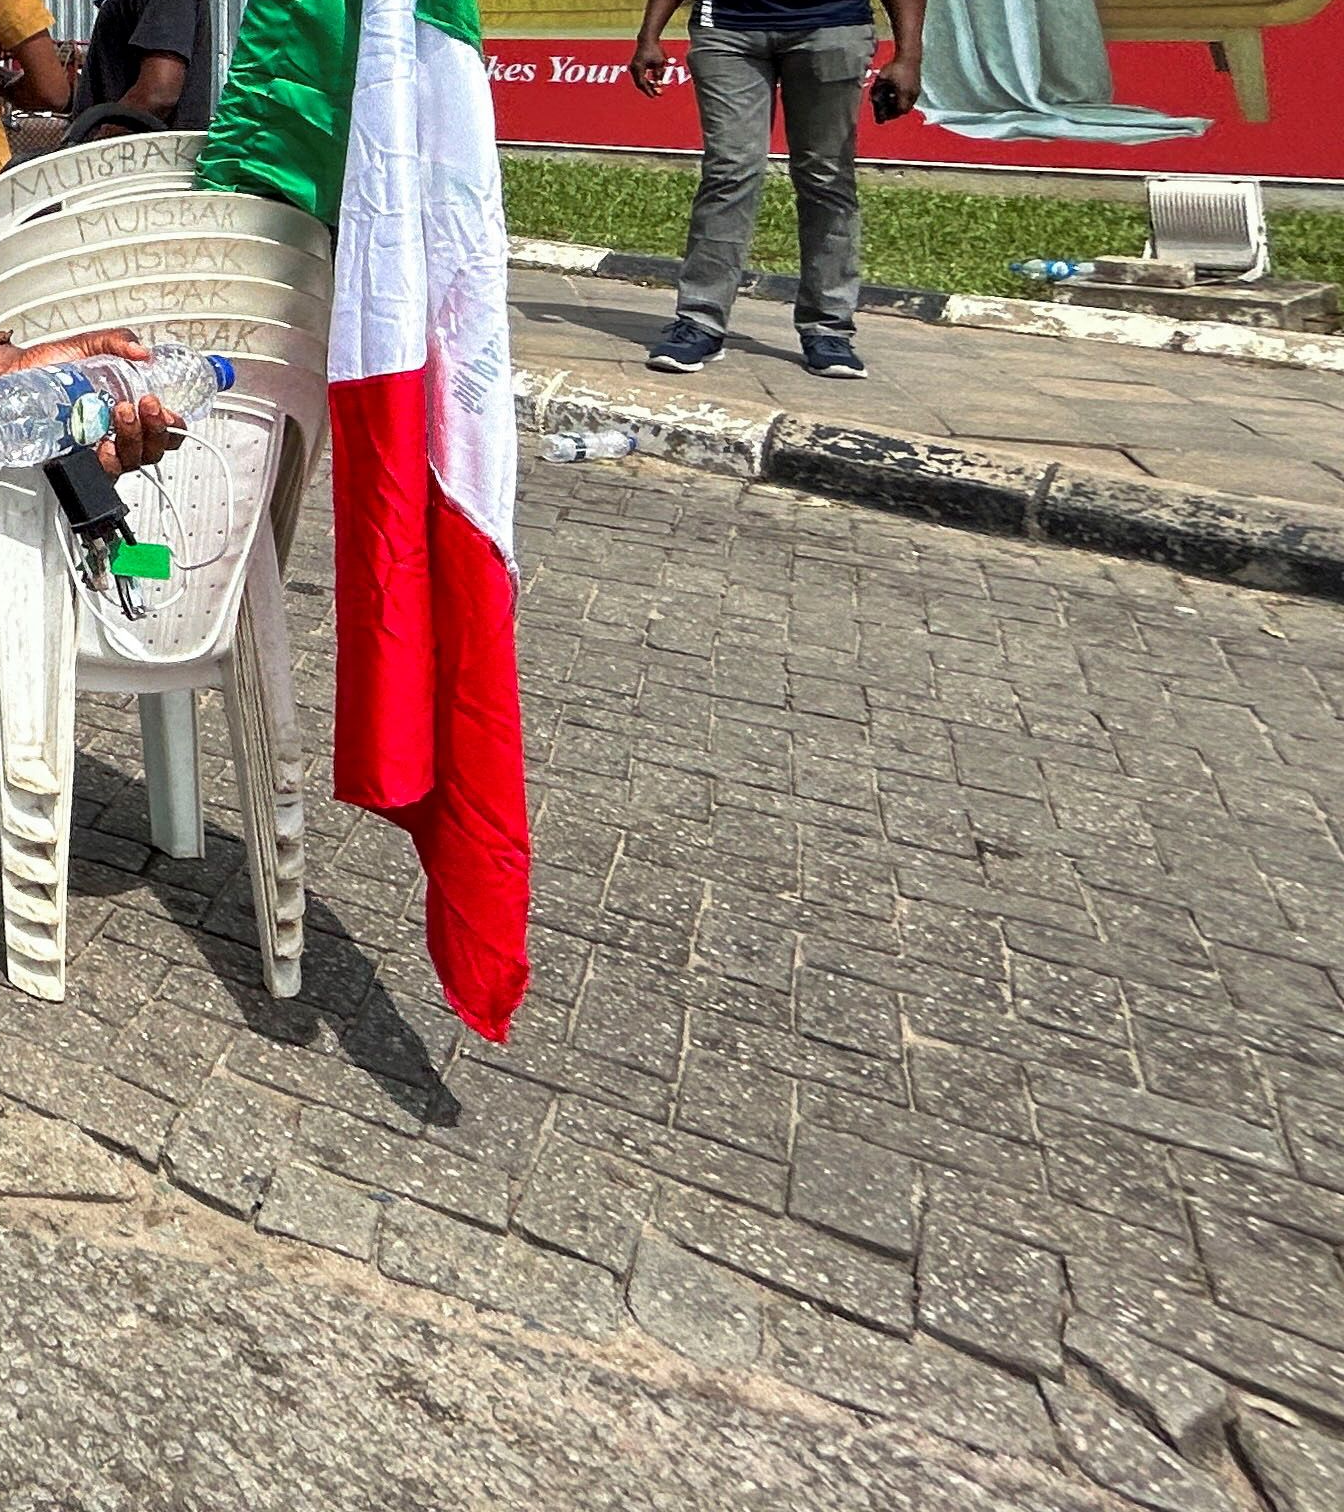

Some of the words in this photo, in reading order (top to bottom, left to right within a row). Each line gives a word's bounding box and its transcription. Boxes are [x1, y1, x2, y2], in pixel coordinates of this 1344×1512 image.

[486, 55, 537, 82] kes
[547, 55, 628, 84] Your
[11, 137, 196, 216] MUISBAK
[75, 199, 238, 243] MUISBAK
[67, 240, 243, 286] MUISBAK
[16, 280, 231, 339] MUISBAK
